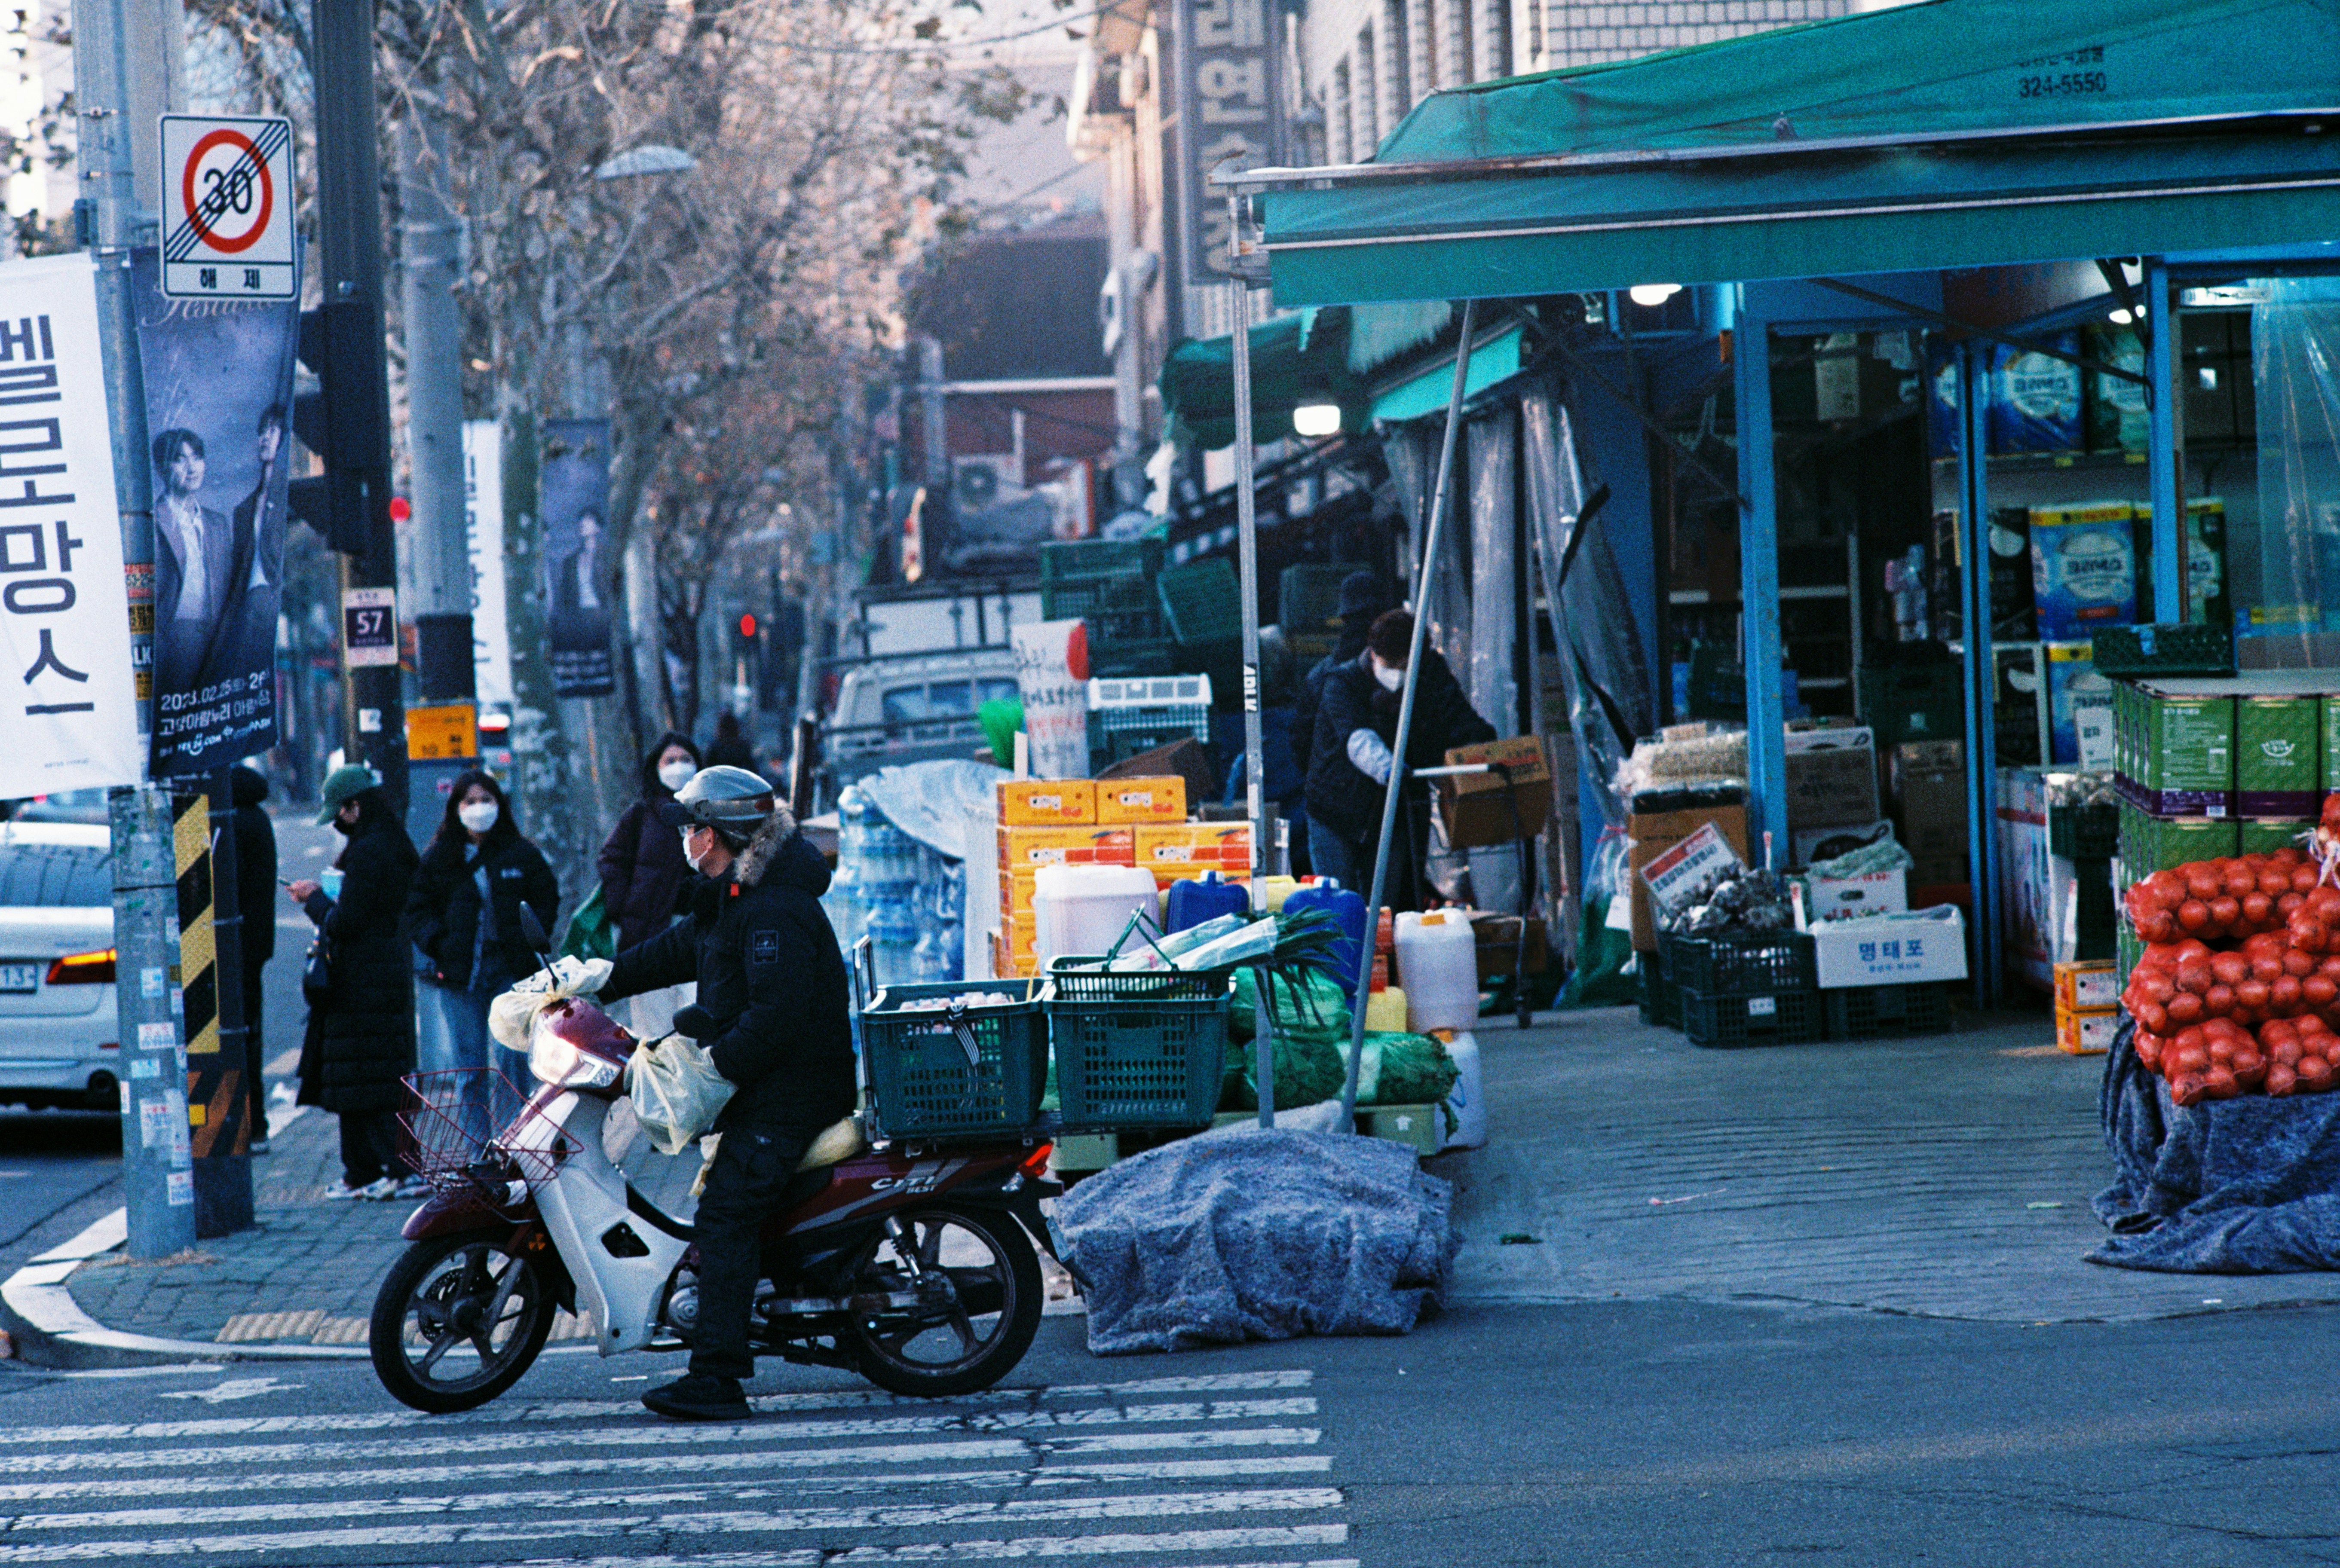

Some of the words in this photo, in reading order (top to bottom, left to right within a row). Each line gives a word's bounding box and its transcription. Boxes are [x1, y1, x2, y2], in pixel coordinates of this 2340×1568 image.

[2019, 71, 2106, 98] 324-5550
[203, 168, 253, 215] 30
[356, 610, 383, 635] 57
[870, 1175, 935, 1190] CITI
[906, 1183, 938, 1195] BEST
